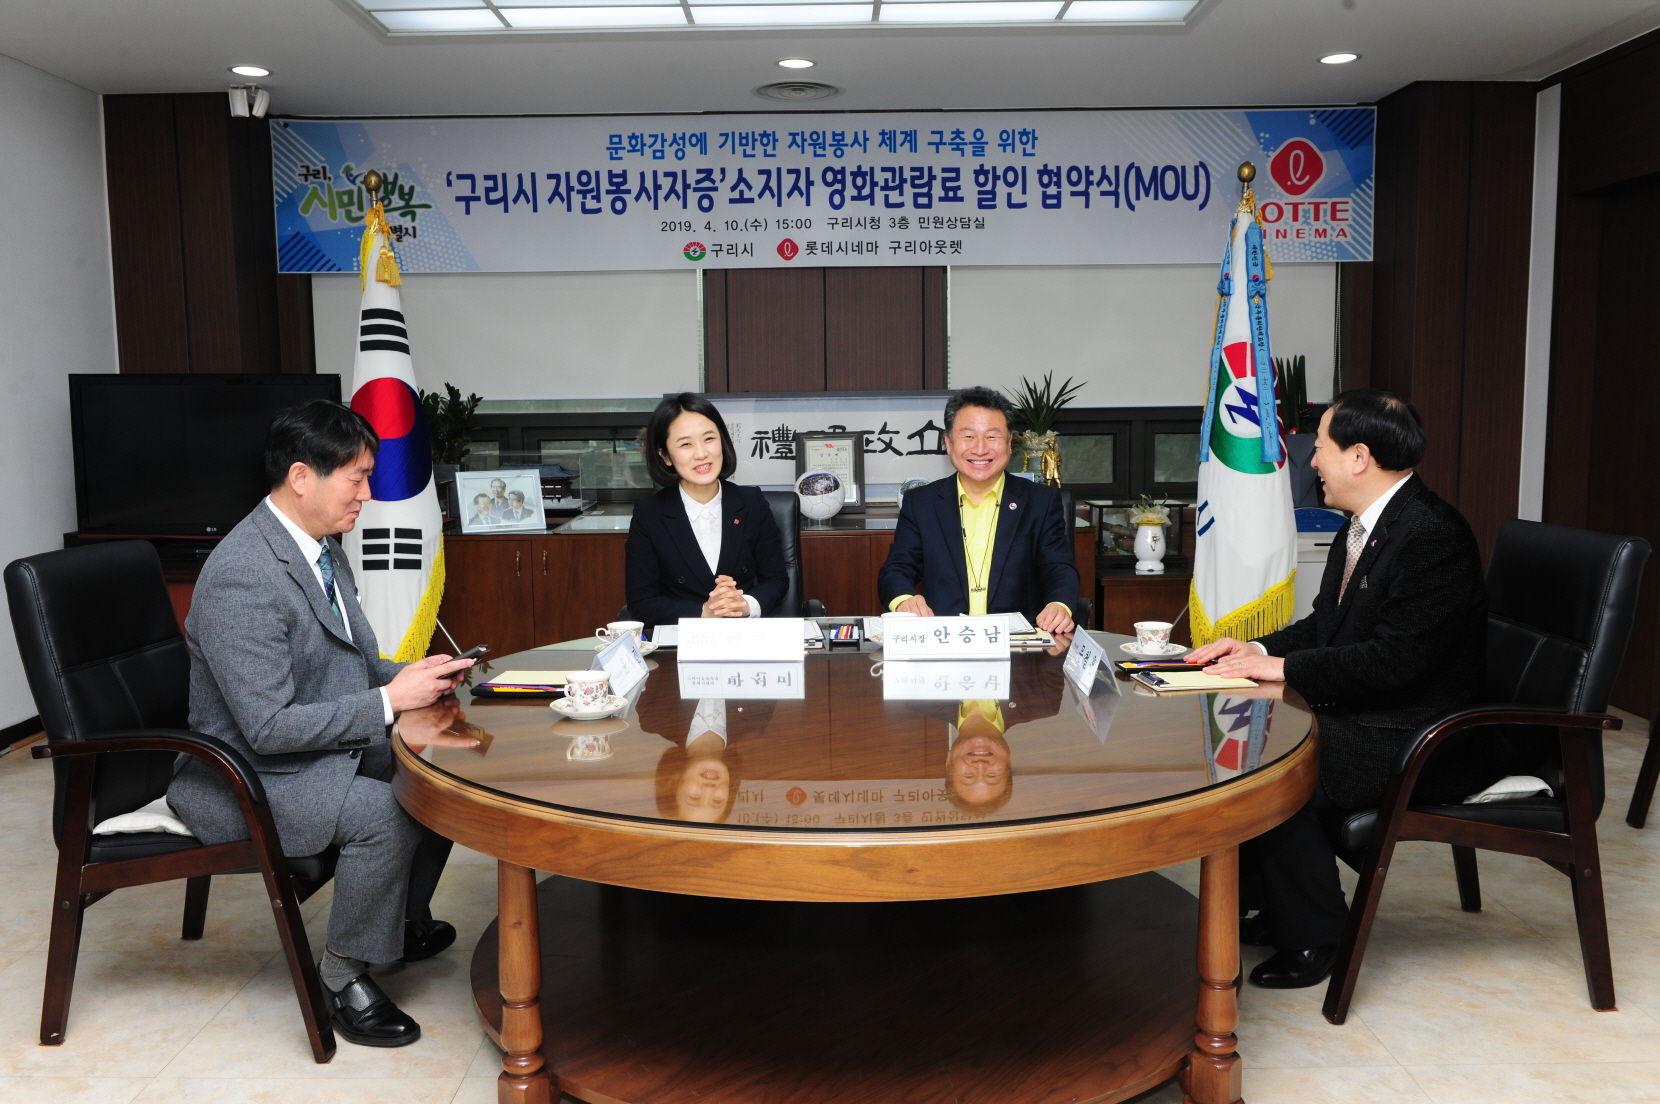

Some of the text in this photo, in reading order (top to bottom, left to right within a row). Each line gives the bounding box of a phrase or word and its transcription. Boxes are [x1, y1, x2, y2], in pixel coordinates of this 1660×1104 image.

[605, 128, 1038, 161] 문화감성에 기반한 자원봉사 체계 구축을 위한
[821, 163, 965, 210] 영화관람료
[973, 163, 1028, 210] 할인
[1037, 160, 1211, 212] 협약식(MOU)
[1260, 201, 1350, 223] OTTE
[661, 215, 986, 232] 2019. 4. 10.(수) 15:00 구리시청 3층 민원상담실
[389, 225, 417, 242] 별시
[1262, 228, 1348, 240] INEMA
[710, 241, 754, 258] 구리시
[804, 239, 963, 256] 롯데시네마 구리아웃렛
[892, 634, 926, 645] 구리시장
